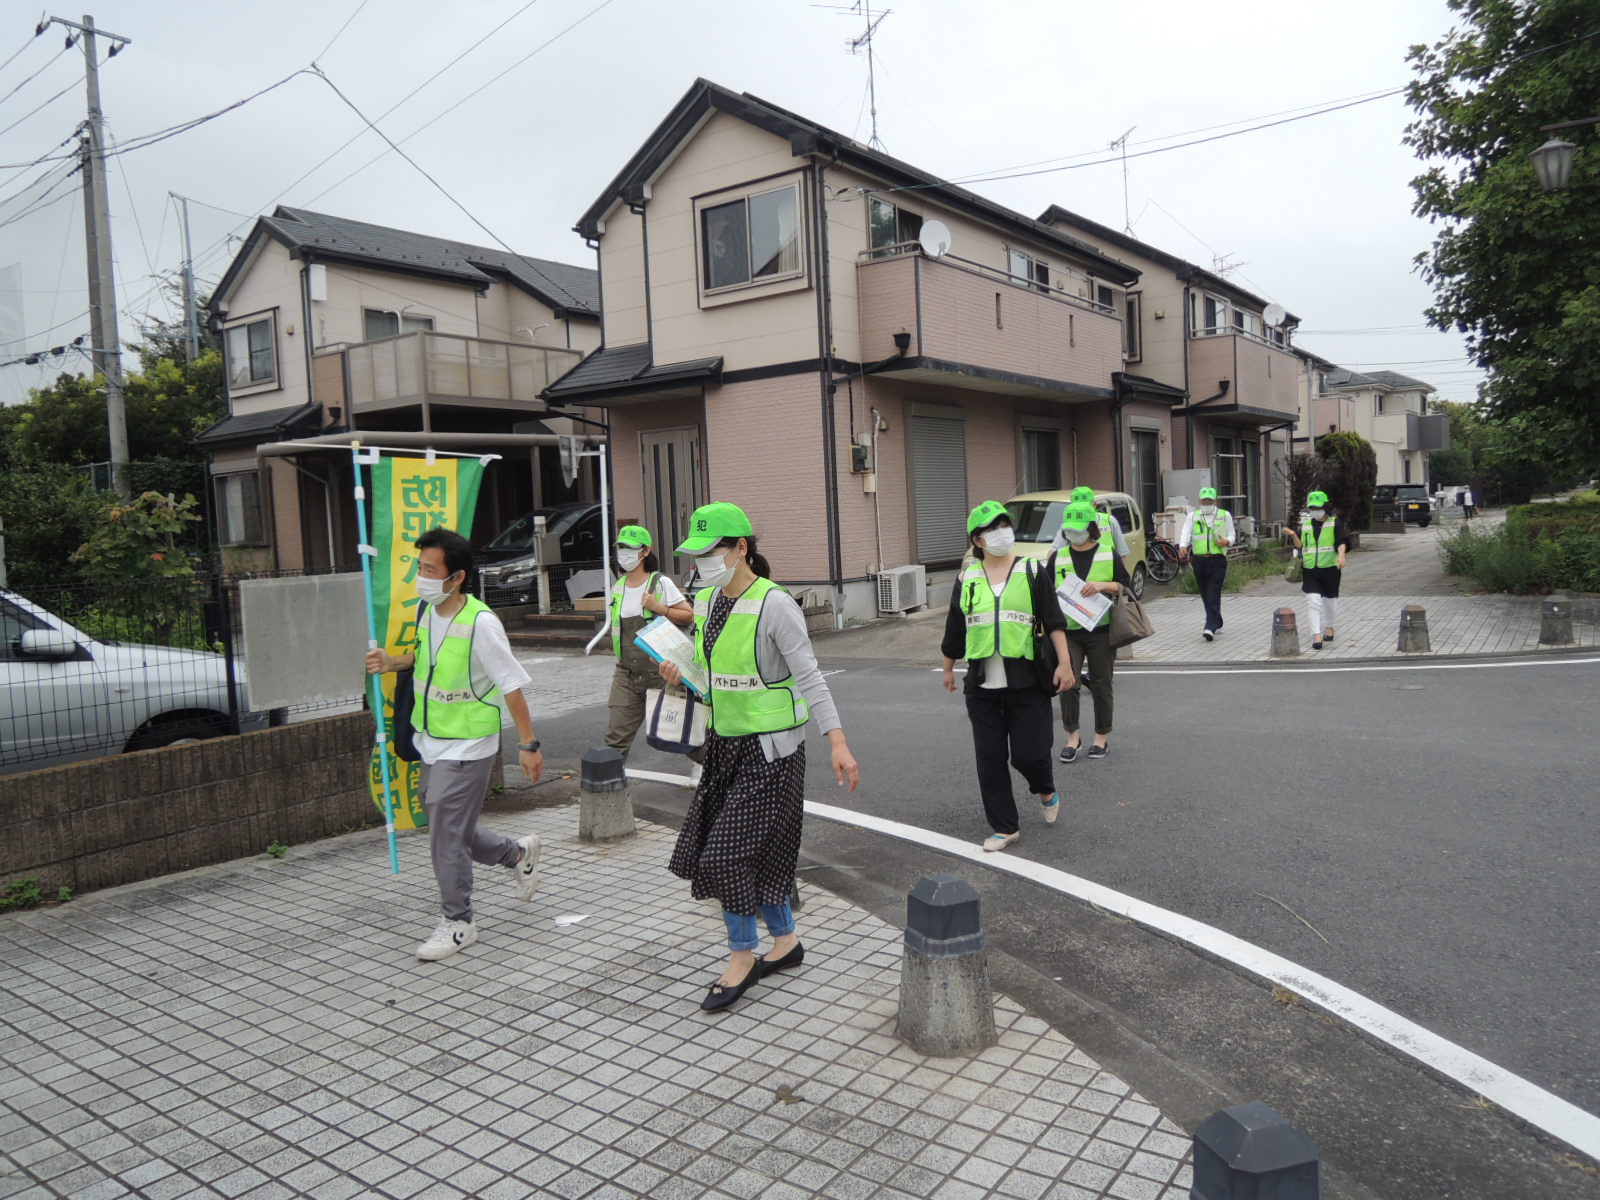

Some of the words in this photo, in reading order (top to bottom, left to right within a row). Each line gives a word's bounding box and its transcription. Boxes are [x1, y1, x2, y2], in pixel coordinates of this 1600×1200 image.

[697, 520, 707, 531] 犯
[714, 678, 758, 688] パトロール
